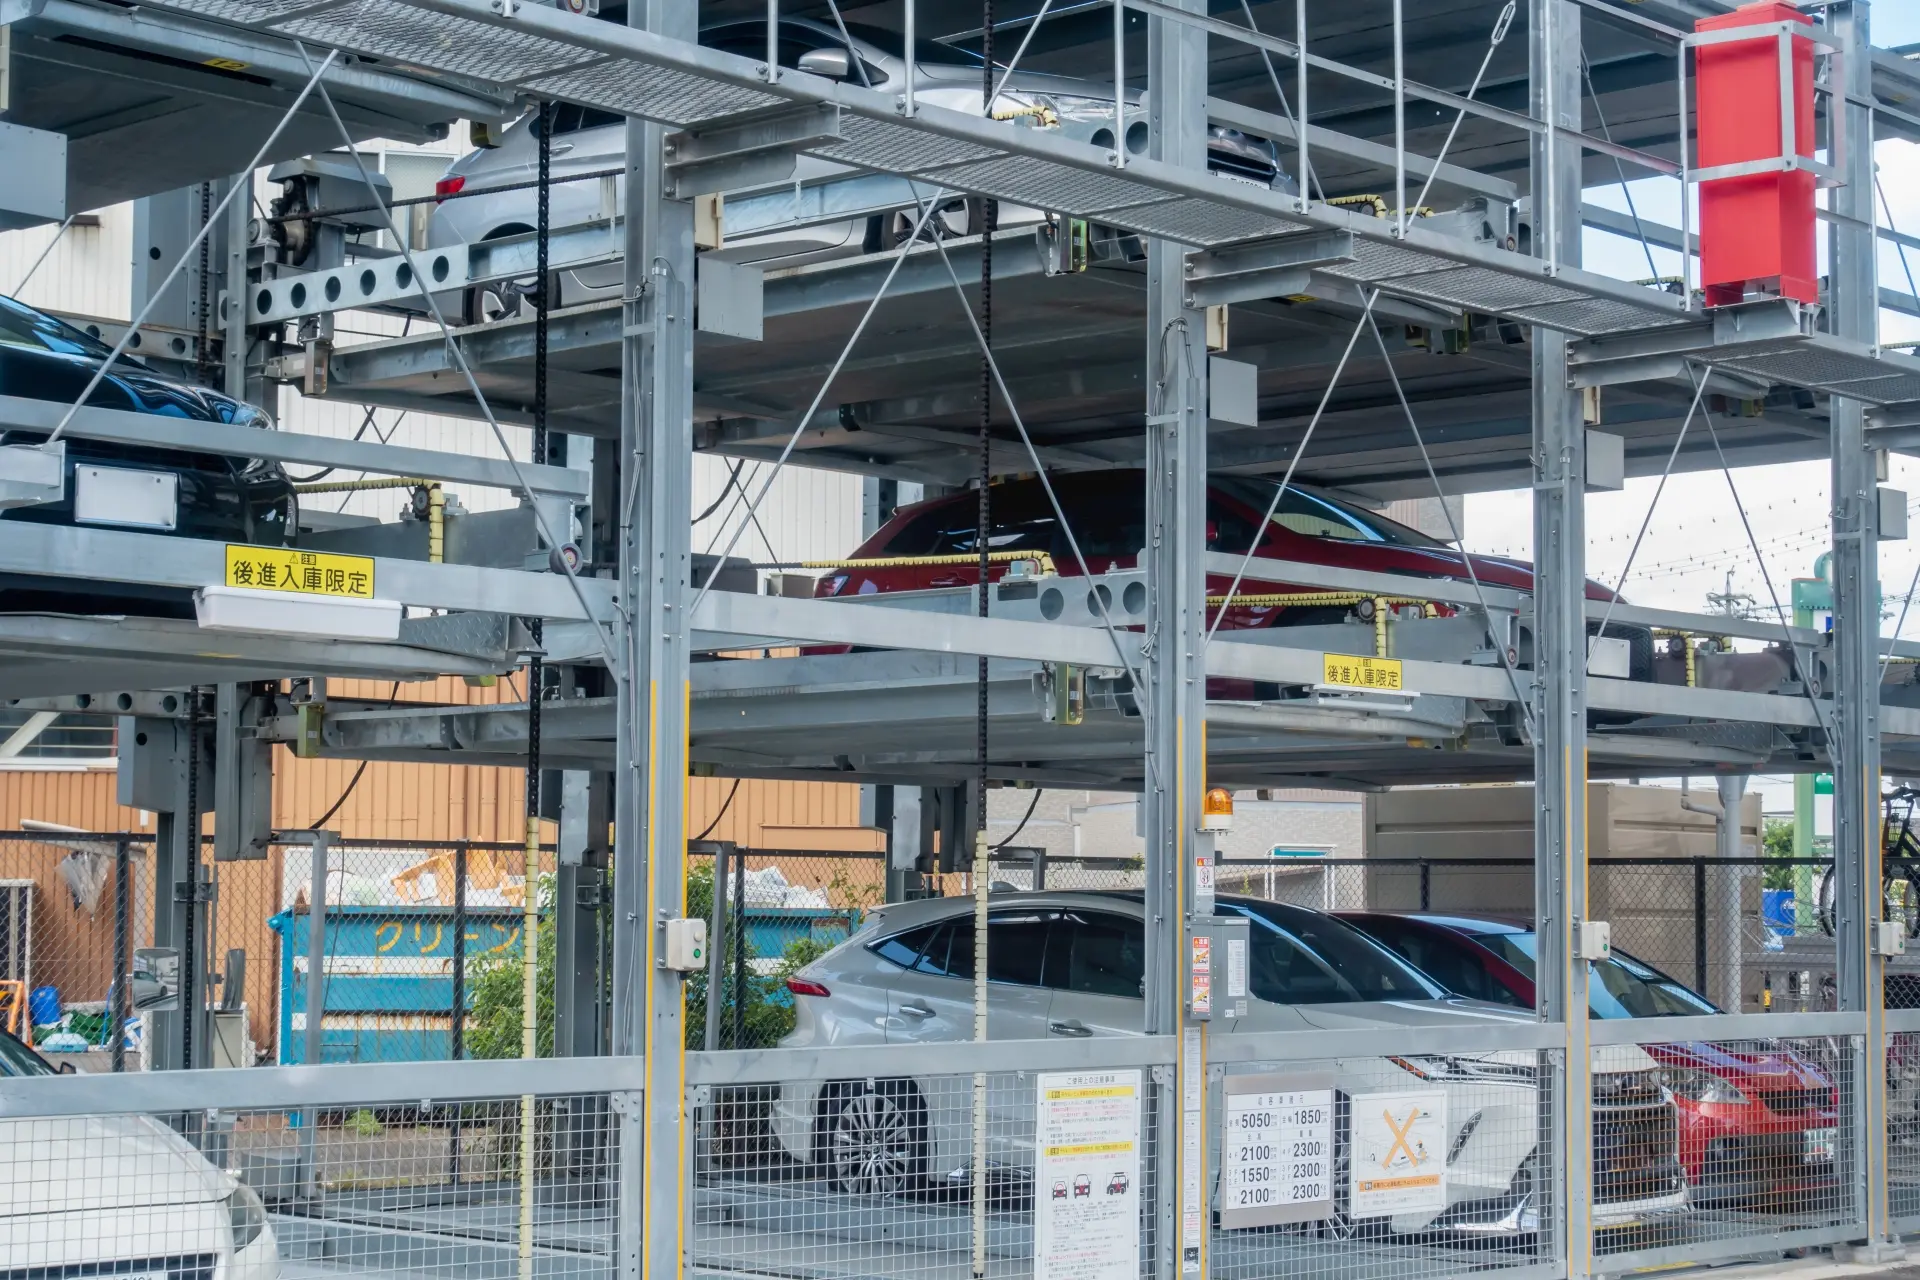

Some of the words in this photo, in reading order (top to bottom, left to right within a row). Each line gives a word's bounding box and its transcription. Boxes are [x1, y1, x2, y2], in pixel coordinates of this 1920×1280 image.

[302, 554, 316, 565] 注意
[233, 560, 367, 594] 後進入庫限定
[1328, 665, 1398, 687] 後進入庫限定
[1241, 1112, 1271, 1128] 5050
[1294, 1109, 1321, 1124] 1850
[1241, 1145, 1270, 1161] 2100
[1293, 1141, 1320, 1157] 2300
[1241, 1167, 1270, 1182] 1550
[1293, 1162, 1320, 1178] 2300
[1240, 1188, 1269, 1204] 2100
[1292, 1183, 1320, 1199] 2300
